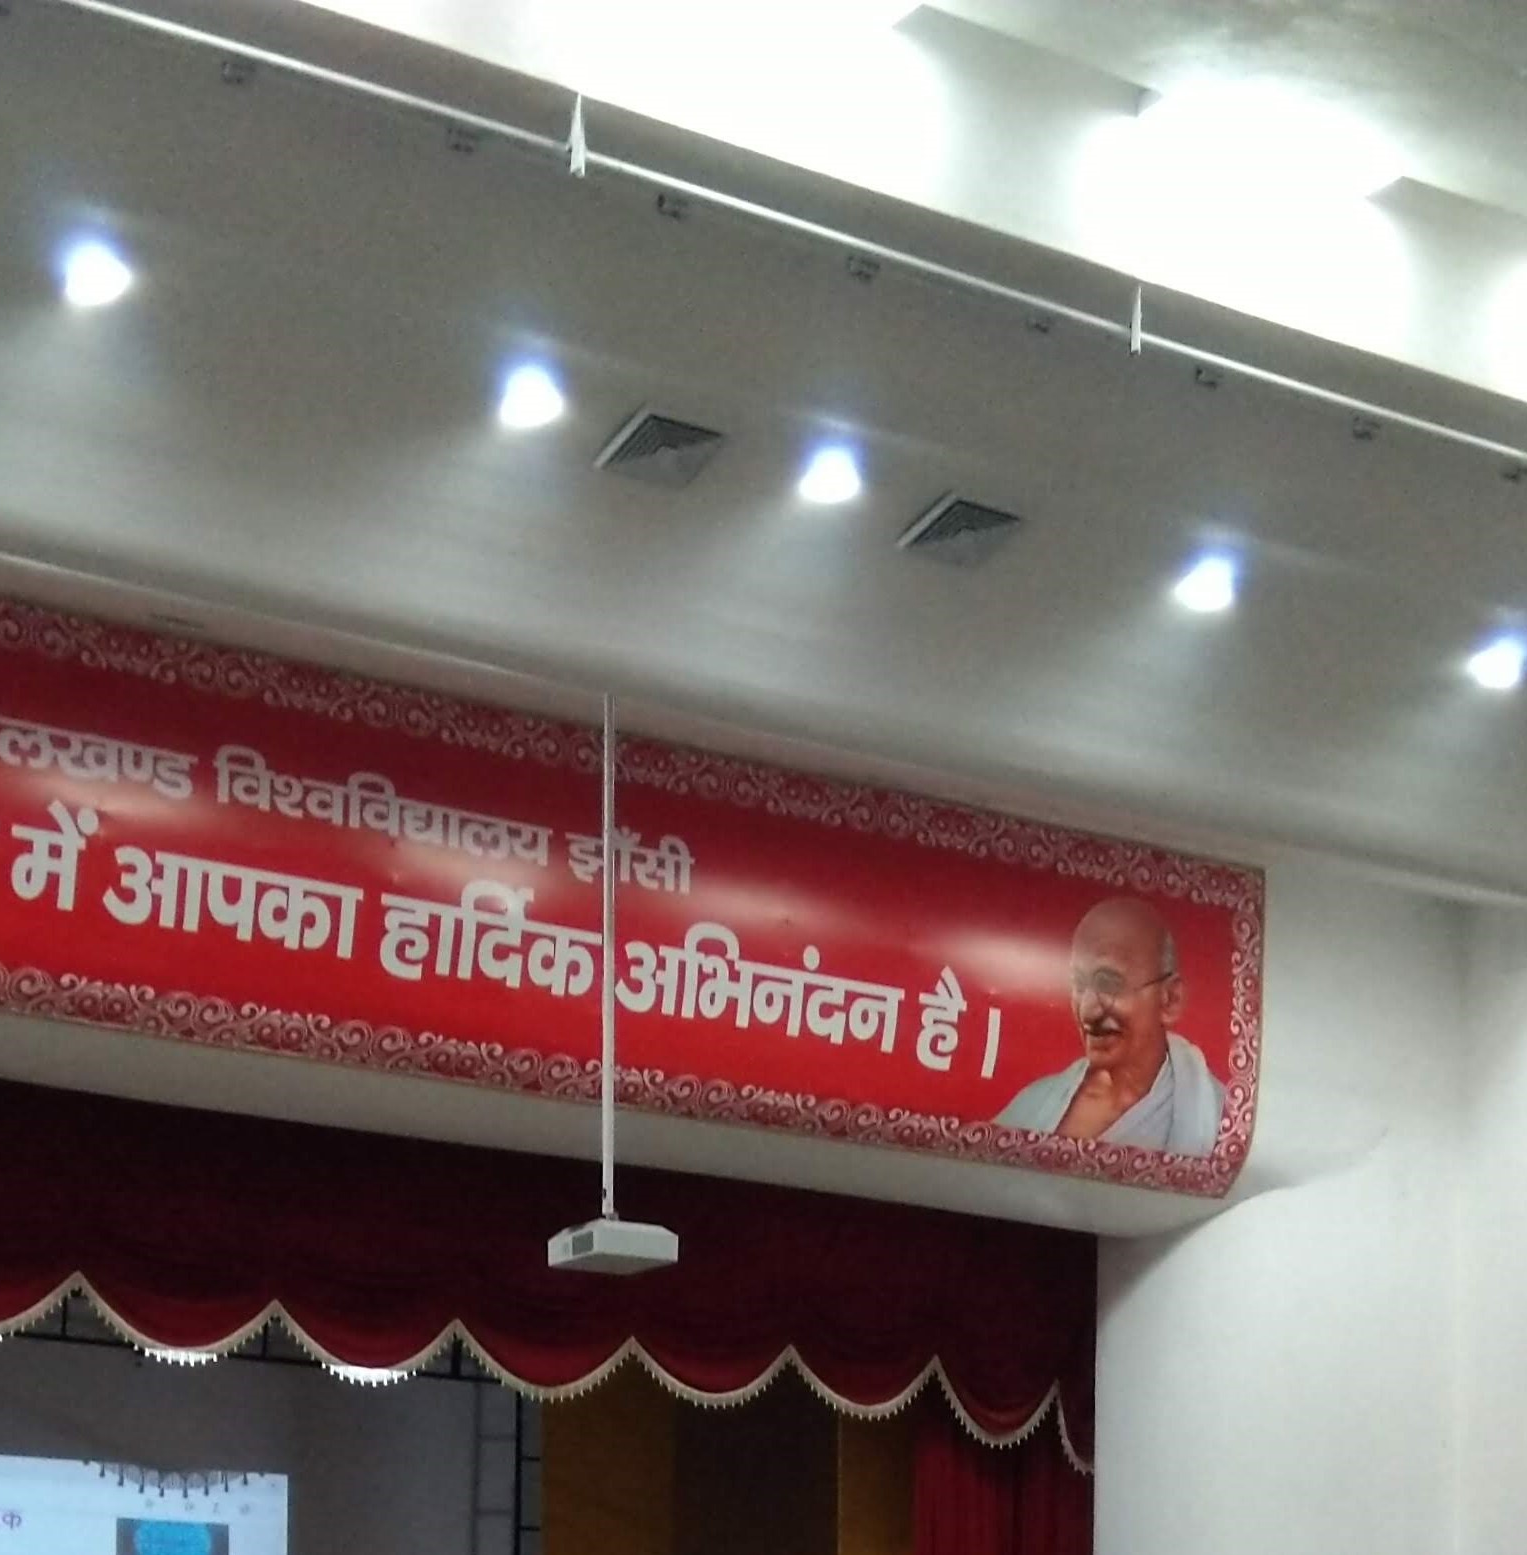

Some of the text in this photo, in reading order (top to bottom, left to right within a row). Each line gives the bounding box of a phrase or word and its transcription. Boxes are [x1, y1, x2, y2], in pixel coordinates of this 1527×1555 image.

[214, 746, 552, 867] विश्वविद्यालय
[11, 801, 99, 912] में
[103, 846, 364, 959] आपका
[379, 880, 602, 997] हार्दिक
[614, 921, 905, 1053] अभिनंदन
[916, 966, 967, 1071] है
